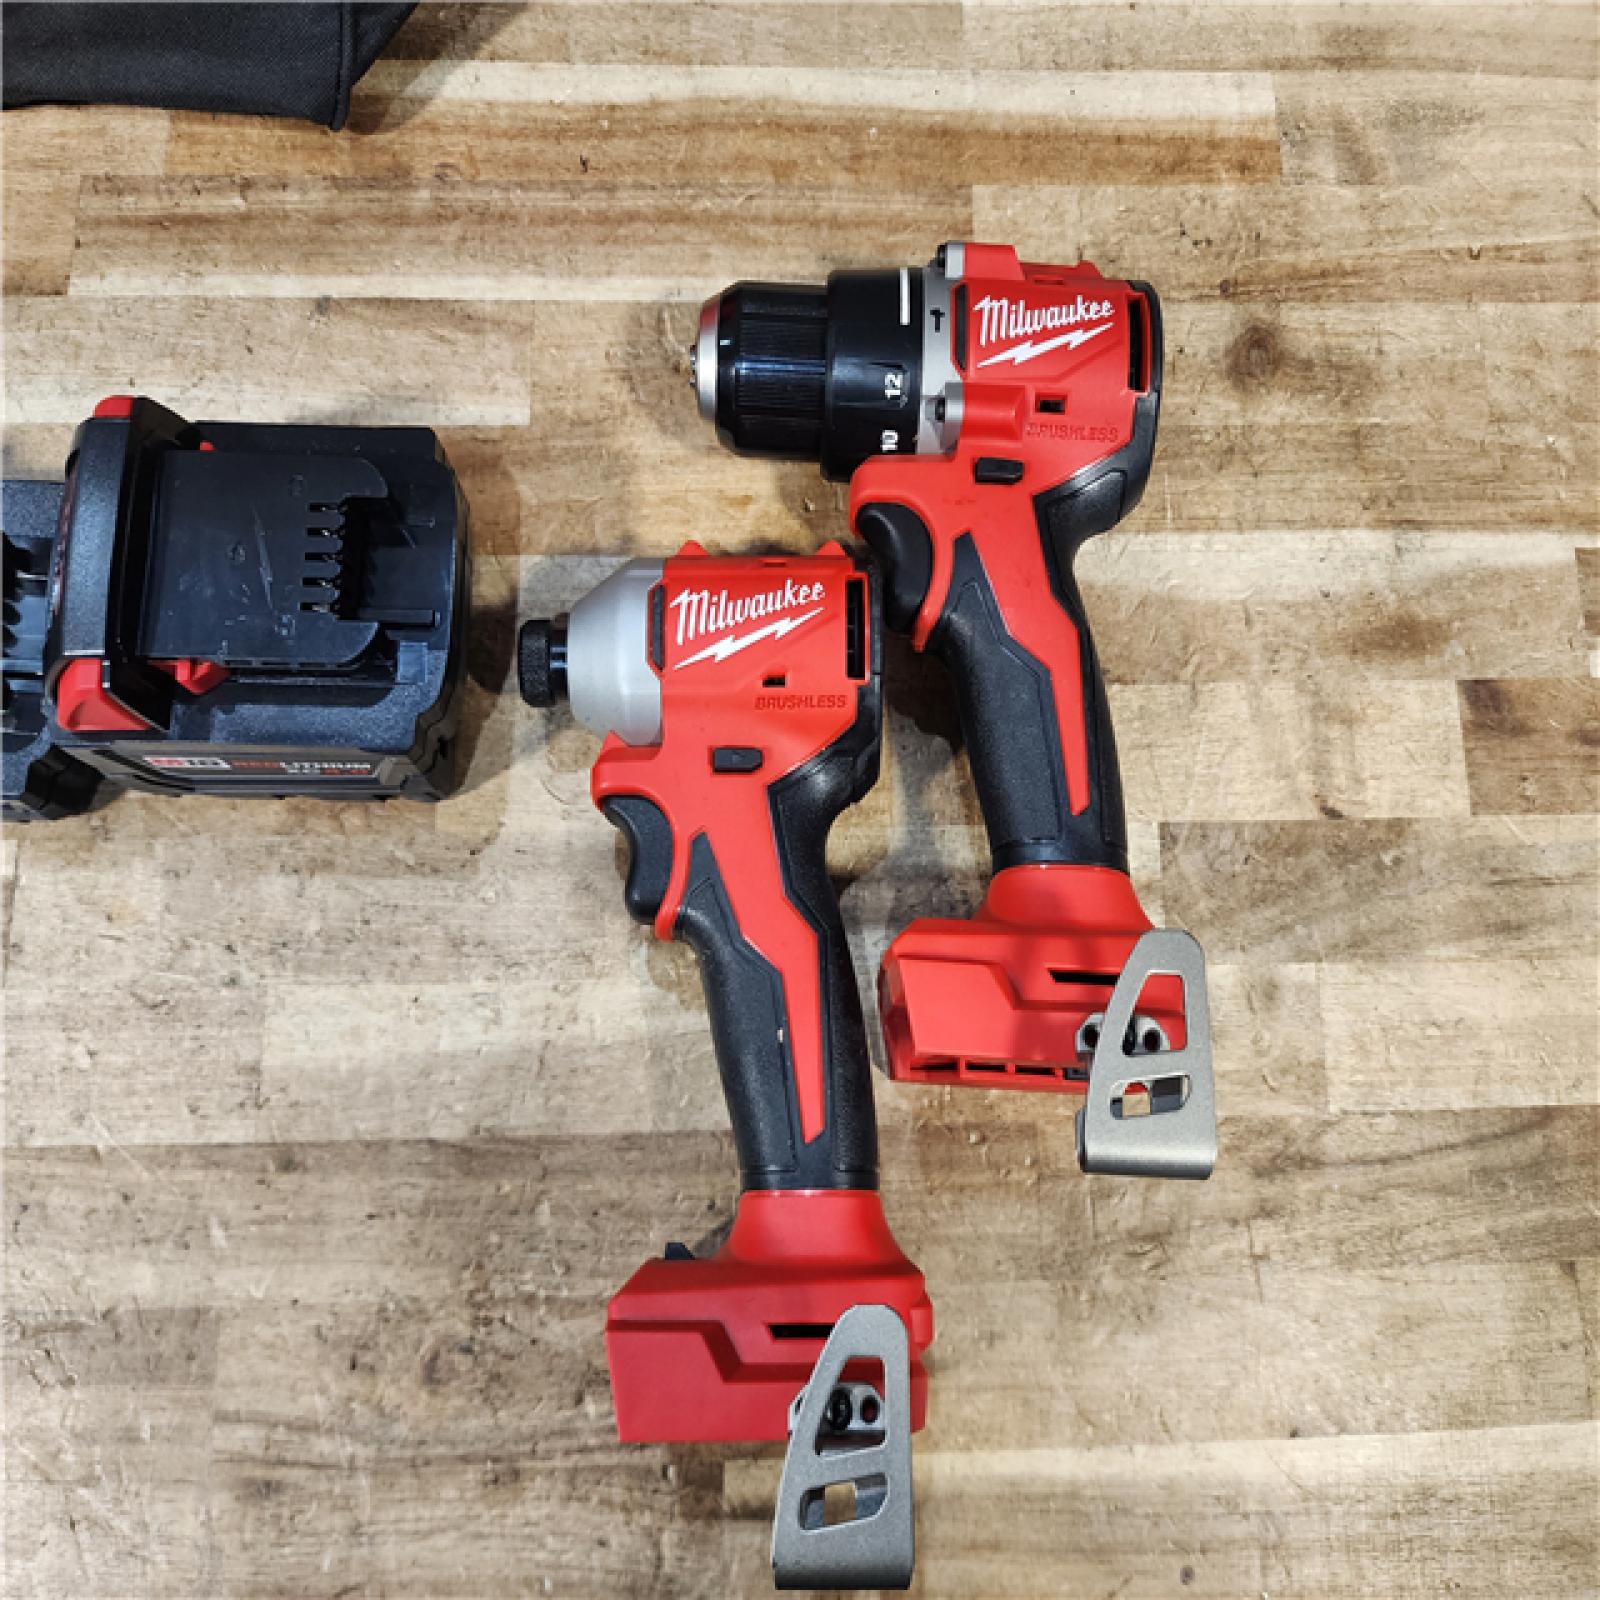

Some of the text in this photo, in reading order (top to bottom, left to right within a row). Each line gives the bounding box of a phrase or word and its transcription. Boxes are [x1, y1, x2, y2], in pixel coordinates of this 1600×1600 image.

[973, 295, 1115, 347] Milwaukee
[884, 374, 903, 399] 12
[881, 430, 898, 451] 10
[669, 578, 825, 645] Milwaukee
[754, 694, 848, 710] BRUSHLESS
